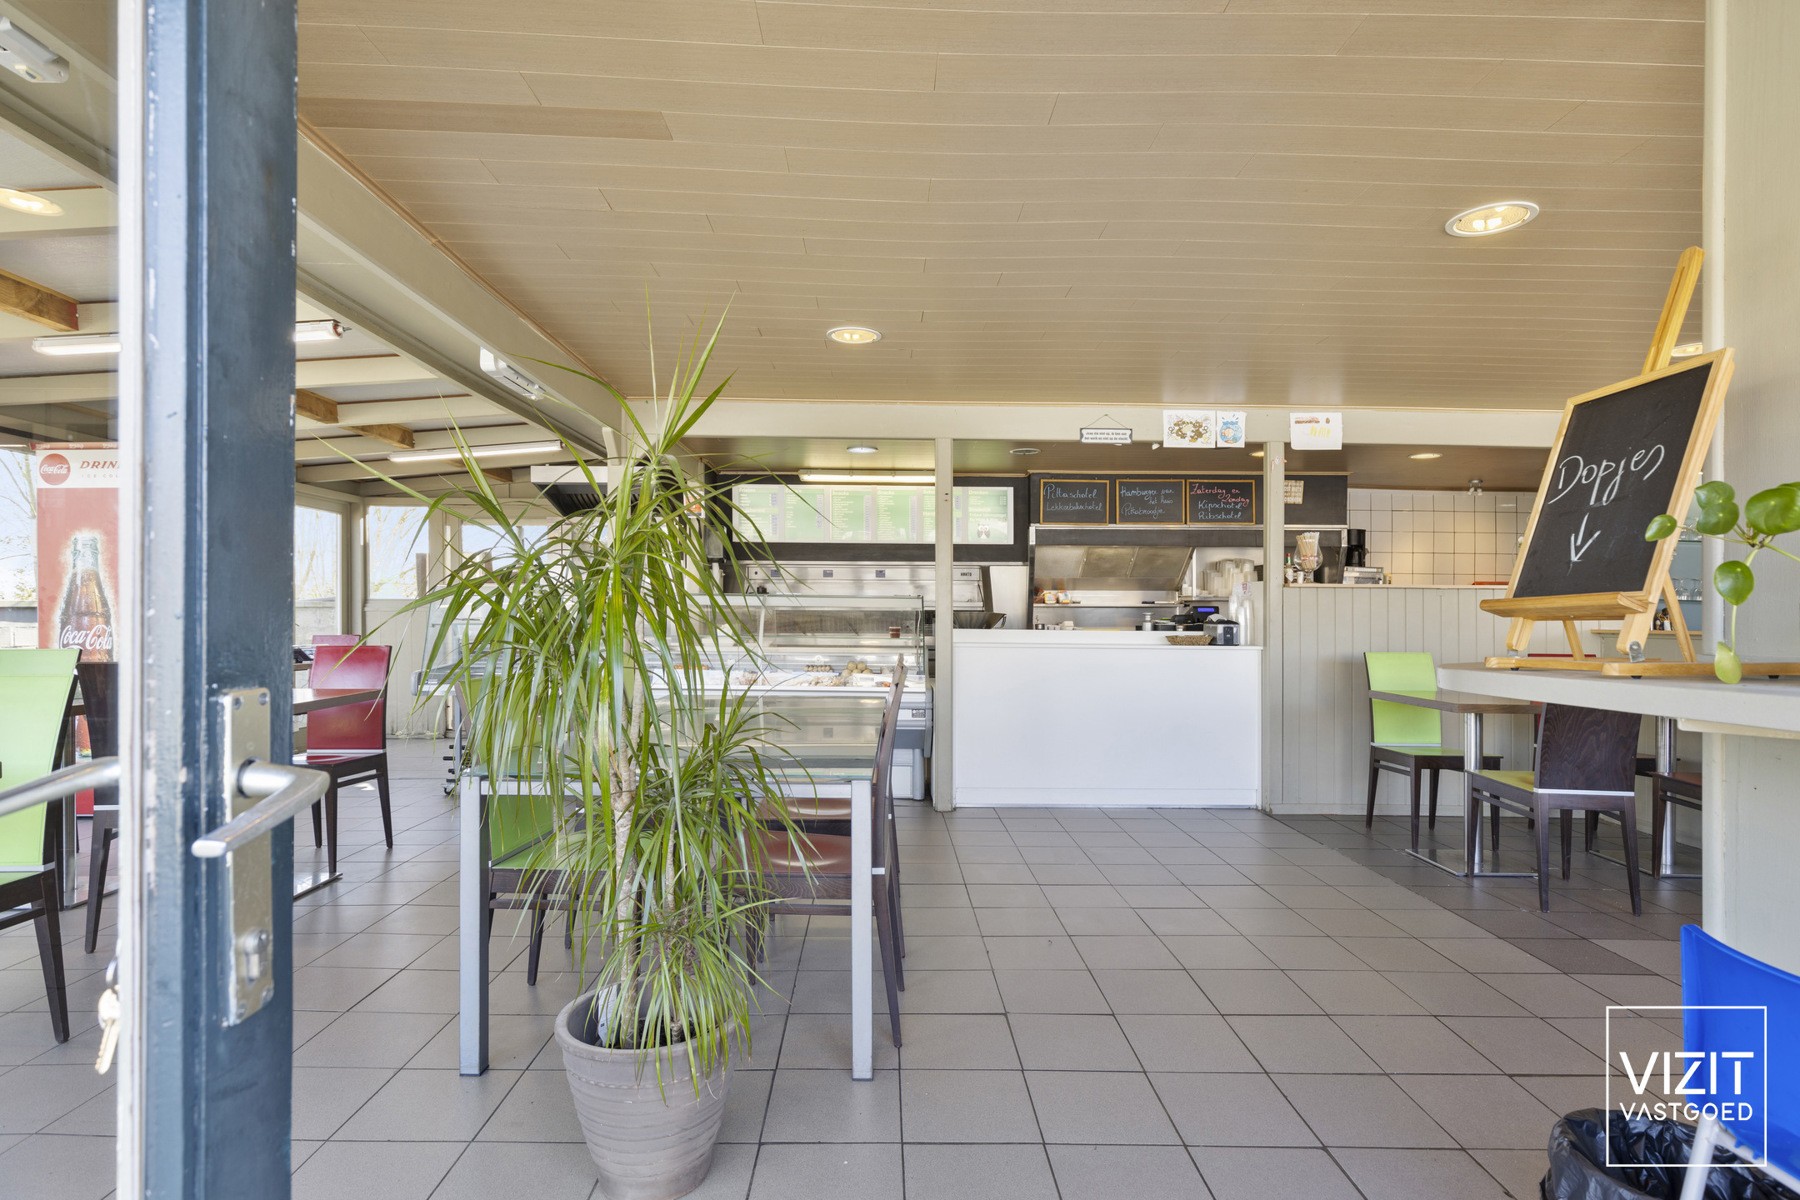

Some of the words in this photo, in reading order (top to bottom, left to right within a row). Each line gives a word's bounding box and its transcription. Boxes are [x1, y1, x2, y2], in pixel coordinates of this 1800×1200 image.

[40, 464, 68, 474] Coca-Cola
[80, 460, 119, 469] DRIN
[1547, 444, 1665, 506] Dopjes
[1190, 483, 1226, 499] Zaterdag
[1198, 500, 1242, 511] Kipschotel
[60, 624, 112, 650] Coca-Cola
